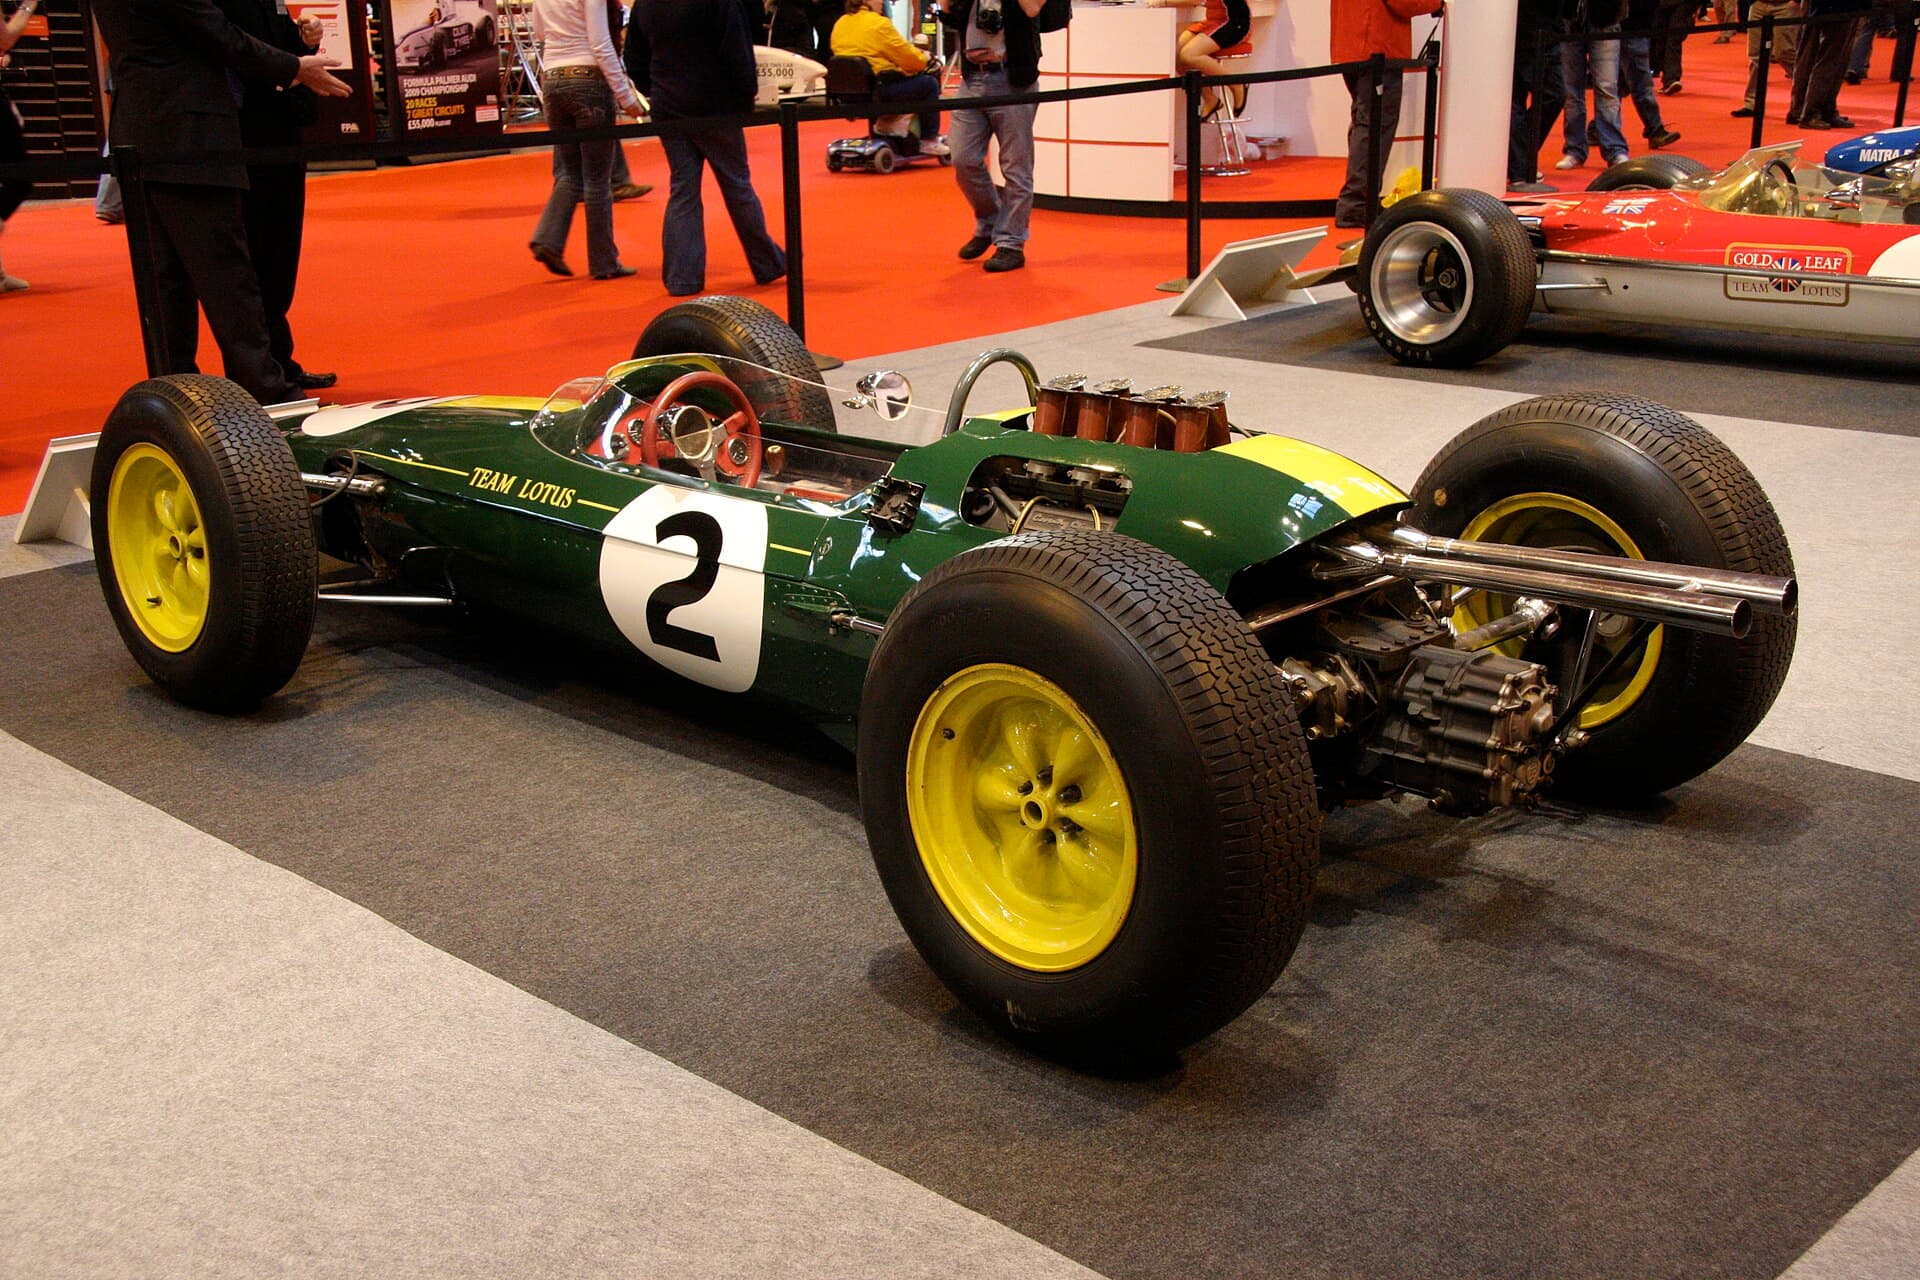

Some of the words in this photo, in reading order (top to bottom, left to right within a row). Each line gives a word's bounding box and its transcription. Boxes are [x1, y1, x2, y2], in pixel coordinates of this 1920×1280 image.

[403, 76, 435, 88] FORMULA
[420, 83, 469, 96] CHAMPIONSHIP
[415, 97, 437, 108] RACES
[412, 107, 433, 119] GREAT
[435, 104, 465, 117] CIRCUITS
[407, 118, 435, 131] £55,000
[1859, 148, 1900, 162] MATRA
[1733, 252, 1773, 267] GOLD
[1804, 256, 1843, 271] LEAF
[1733, 281, 1769, 293] TEAM
[1801, 285, 1842, 298] LOTUS
[469, 466, 518, 495] TEAM
[517, 479, 577, 509] LOTUS
[646, 511, 723, 663] 2
